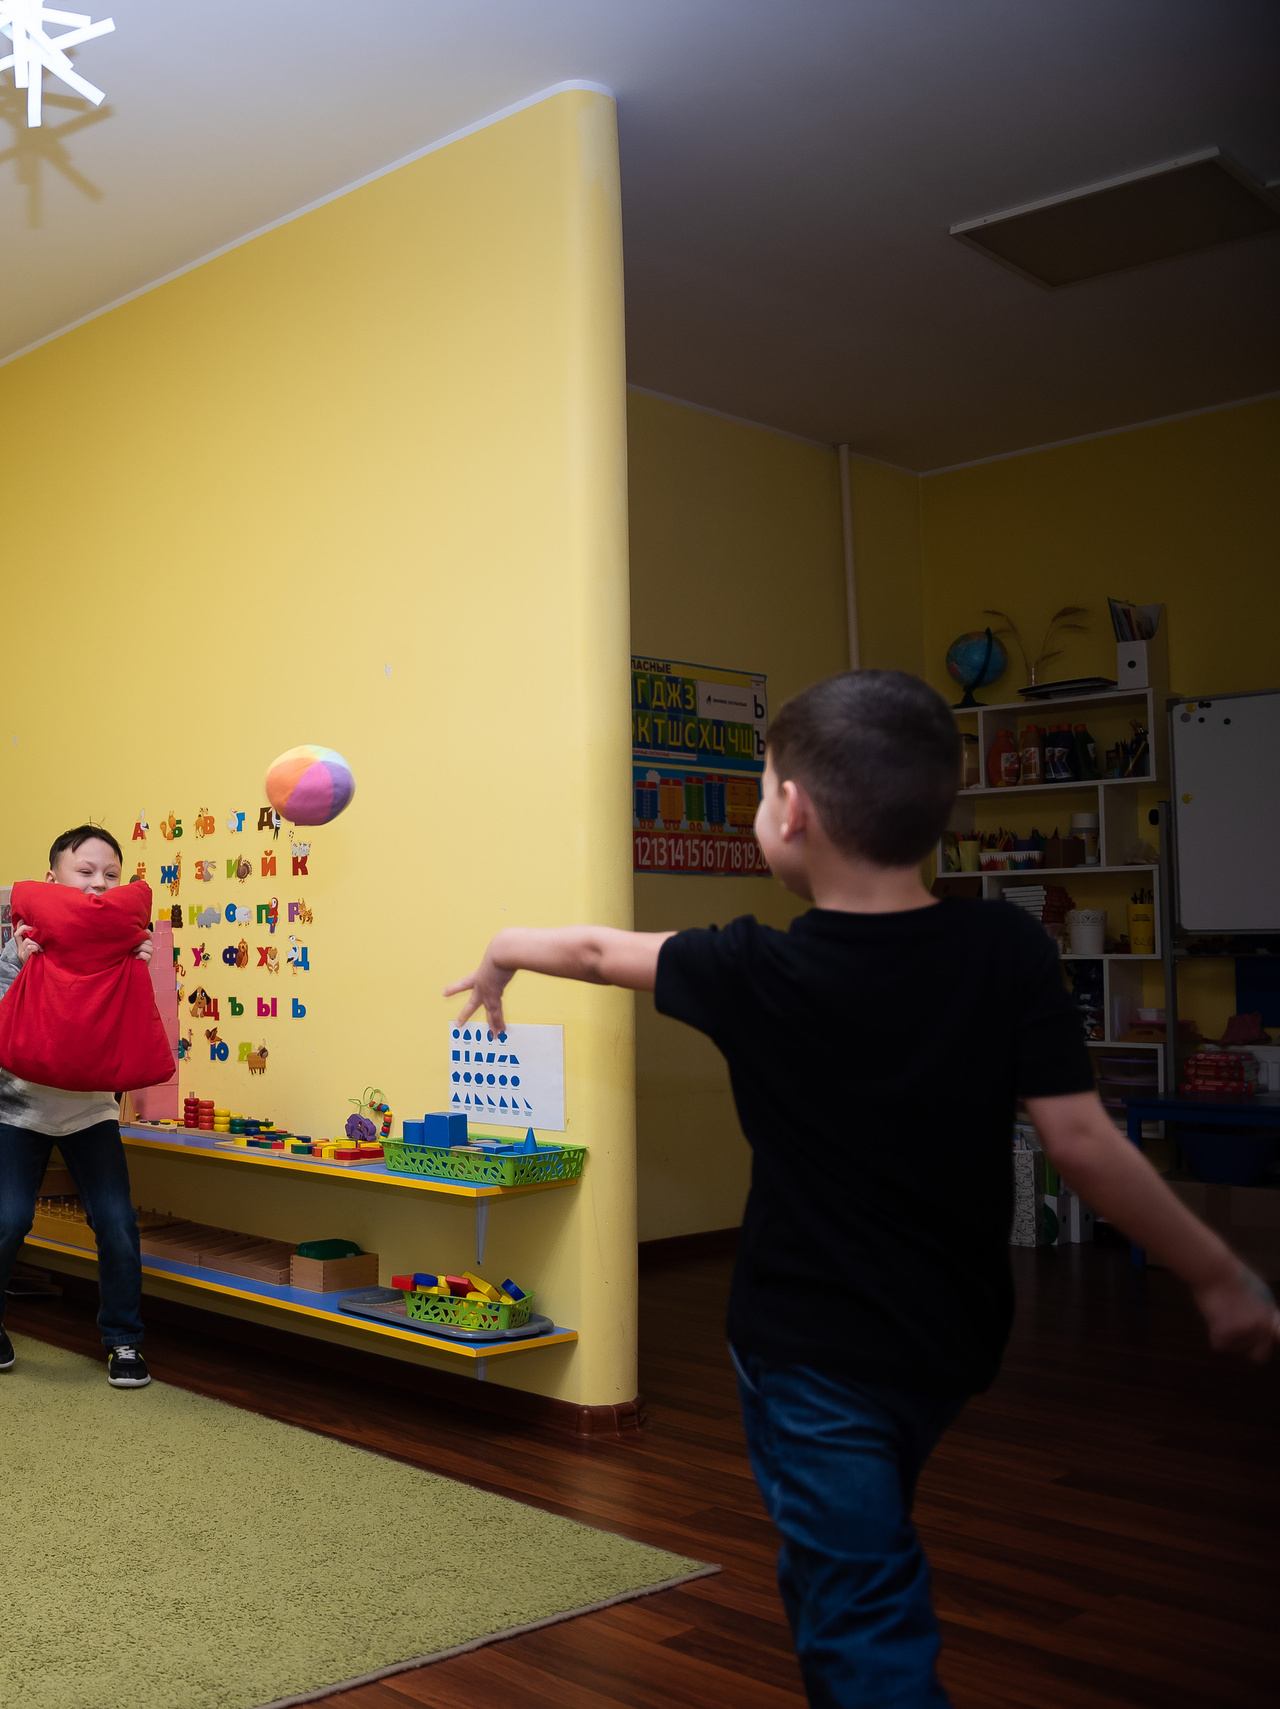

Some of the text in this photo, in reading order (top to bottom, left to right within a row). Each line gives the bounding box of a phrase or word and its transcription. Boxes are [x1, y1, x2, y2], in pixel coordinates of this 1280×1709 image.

[203, 816, 215, 835] В
[258, 806, 274, 831] Д
[636, 837, 651, 865] 12
[651, 837, 667, 865] 13
[668, 838, 684, 866] 14
[686, 839, 700, 867] 15
[701, 840, 714, 867] 16
[715, 841, 728, 868] 17
[729, 841, 741, 869] 18
[742, 842, 756, 869] 19
[160, 866, 179, 884] Ж
[261, 850, 276, 876] Й
[292, 855, 308, 876] К
[188, 905, 202, 925] Н
[256, 904, 271, 924] П
[288, 902, 300, 923] Р
[192, 947, 206, 967] У
[222, 945, 239, 967] Ф
[228, 997, 244, 1017] Ъ
[257, 997, 278, 1017] Ы
[291, 998, 306, 1018] Ь
[210, 1041, 252, 1062] Ю Я
